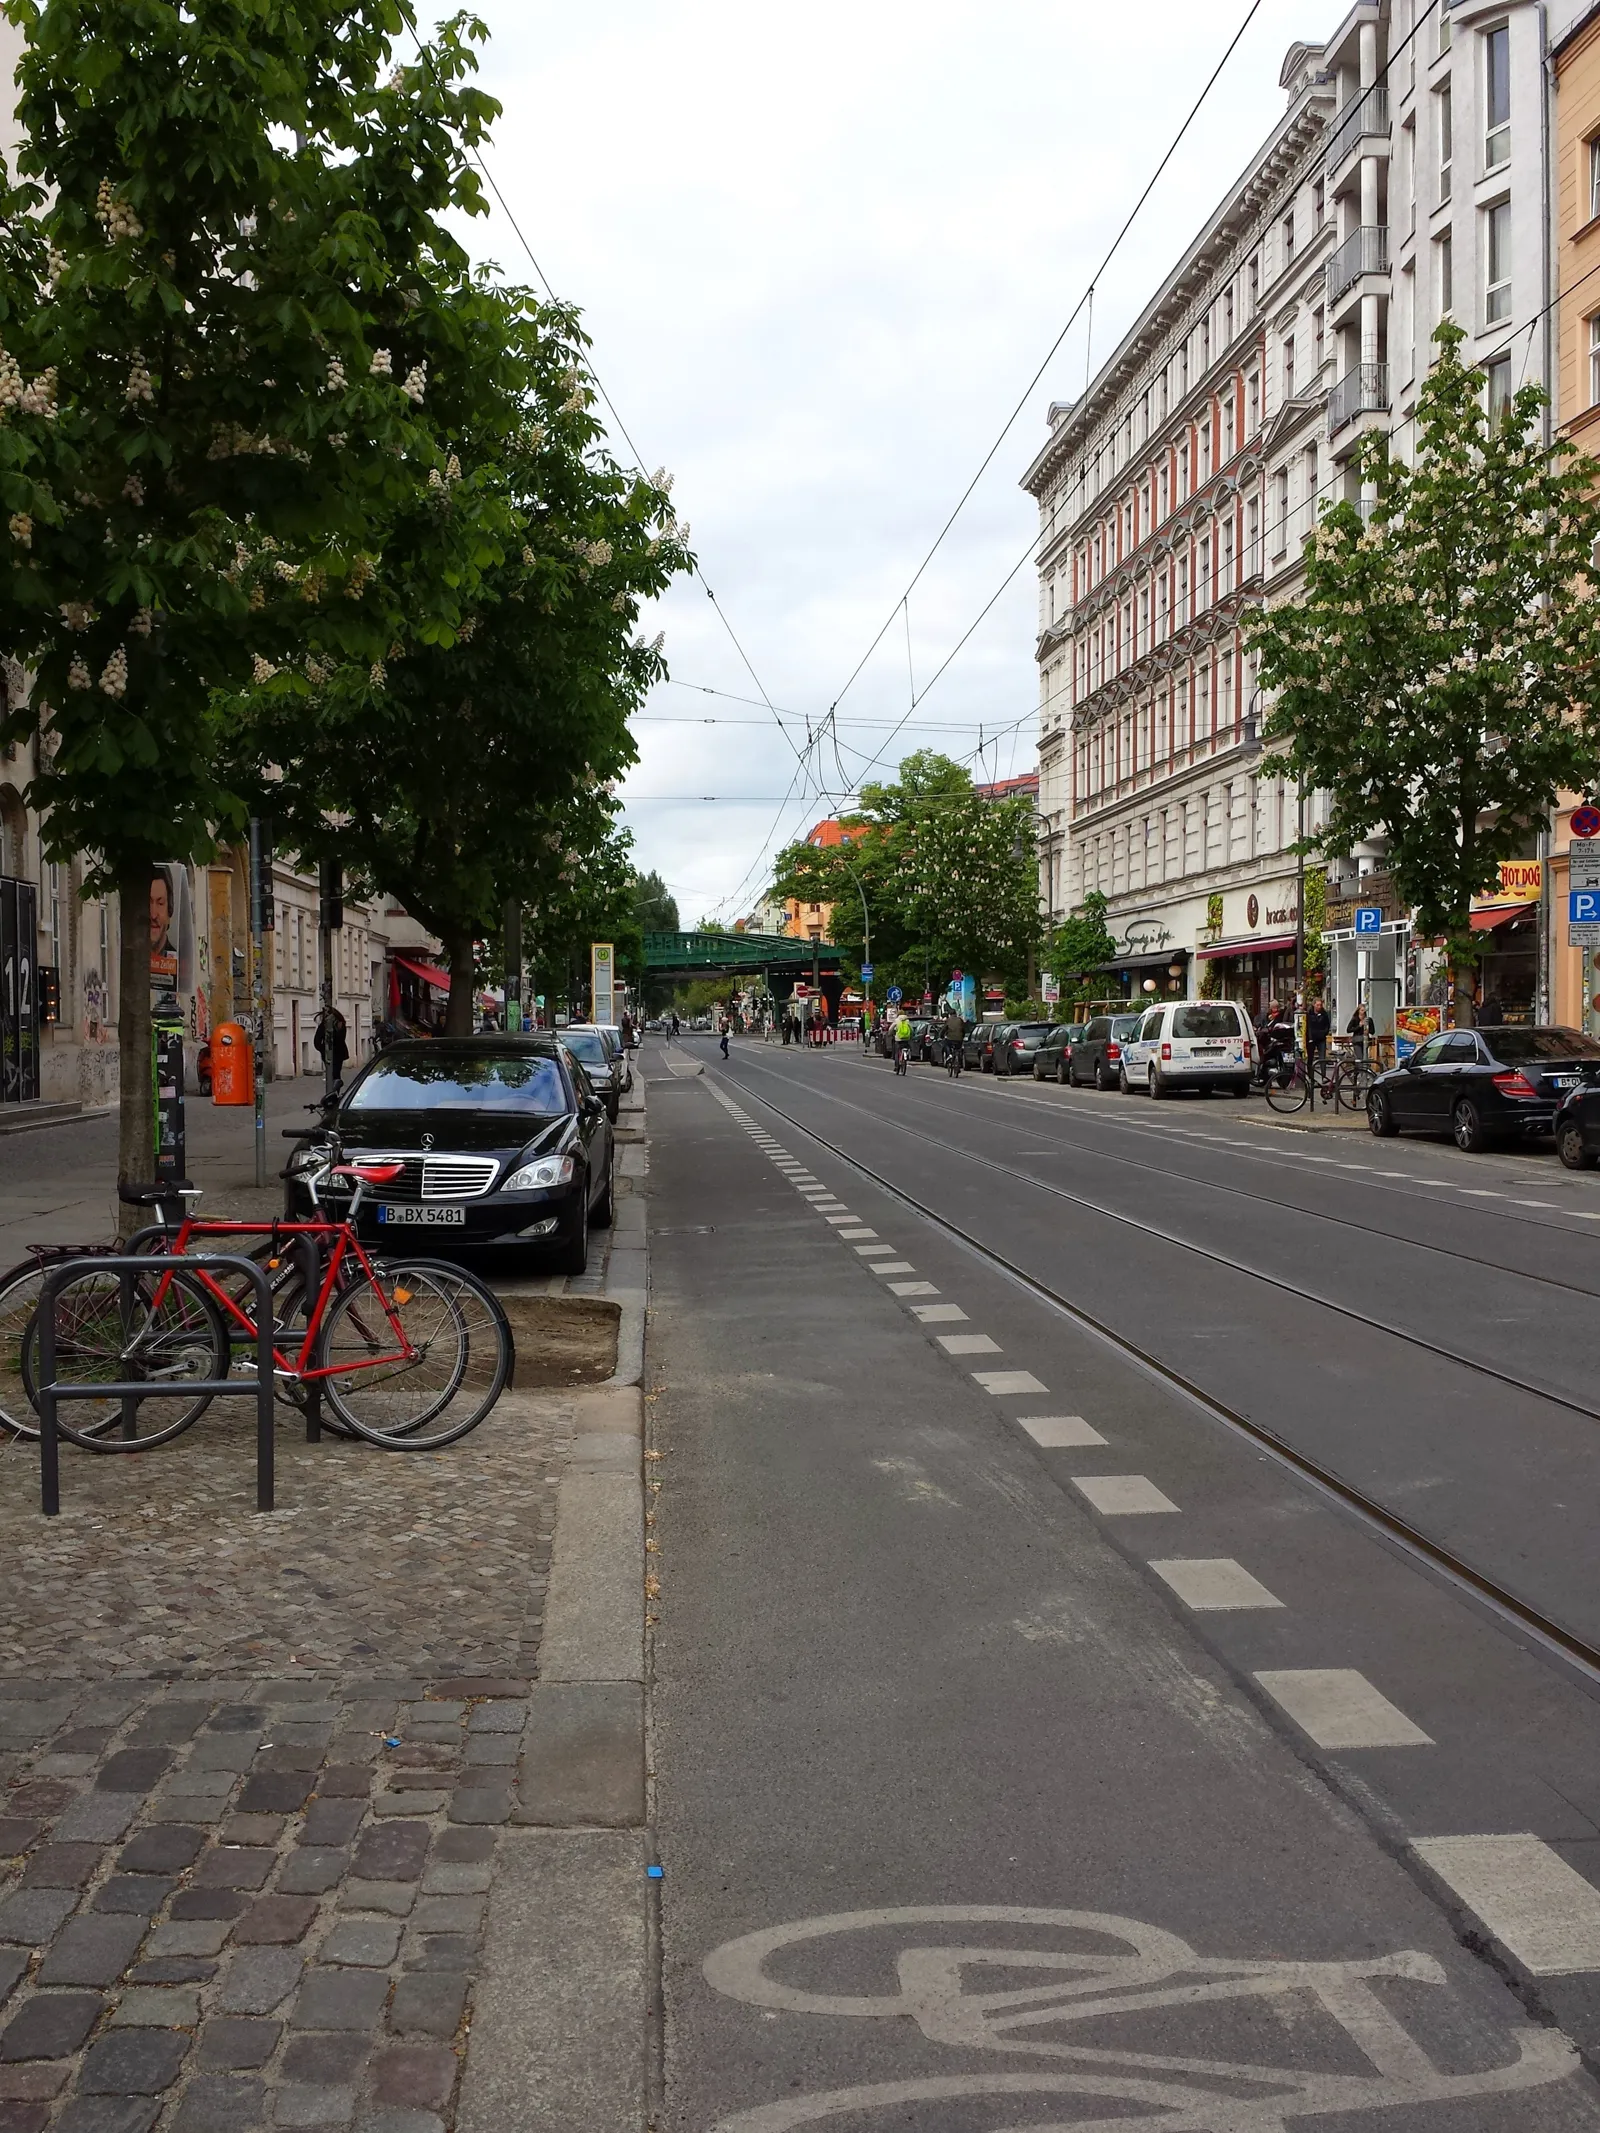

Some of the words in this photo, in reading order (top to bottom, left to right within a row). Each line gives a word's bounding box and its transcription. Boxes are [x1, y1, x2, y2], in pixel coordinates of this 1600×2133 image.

[1501, 865, 1520, 886] HOT
[1522, 865, 1540, 886] DOG
[1576, 894, 1595, 919] P
[1361, 911, 1376, 930] P
[4, 956, 31, 1016] 12
[386, 1207, 396, 1222] B
[404, 1208, 424, 1223] BX
[426, 1208, 463, 1223] 5481
